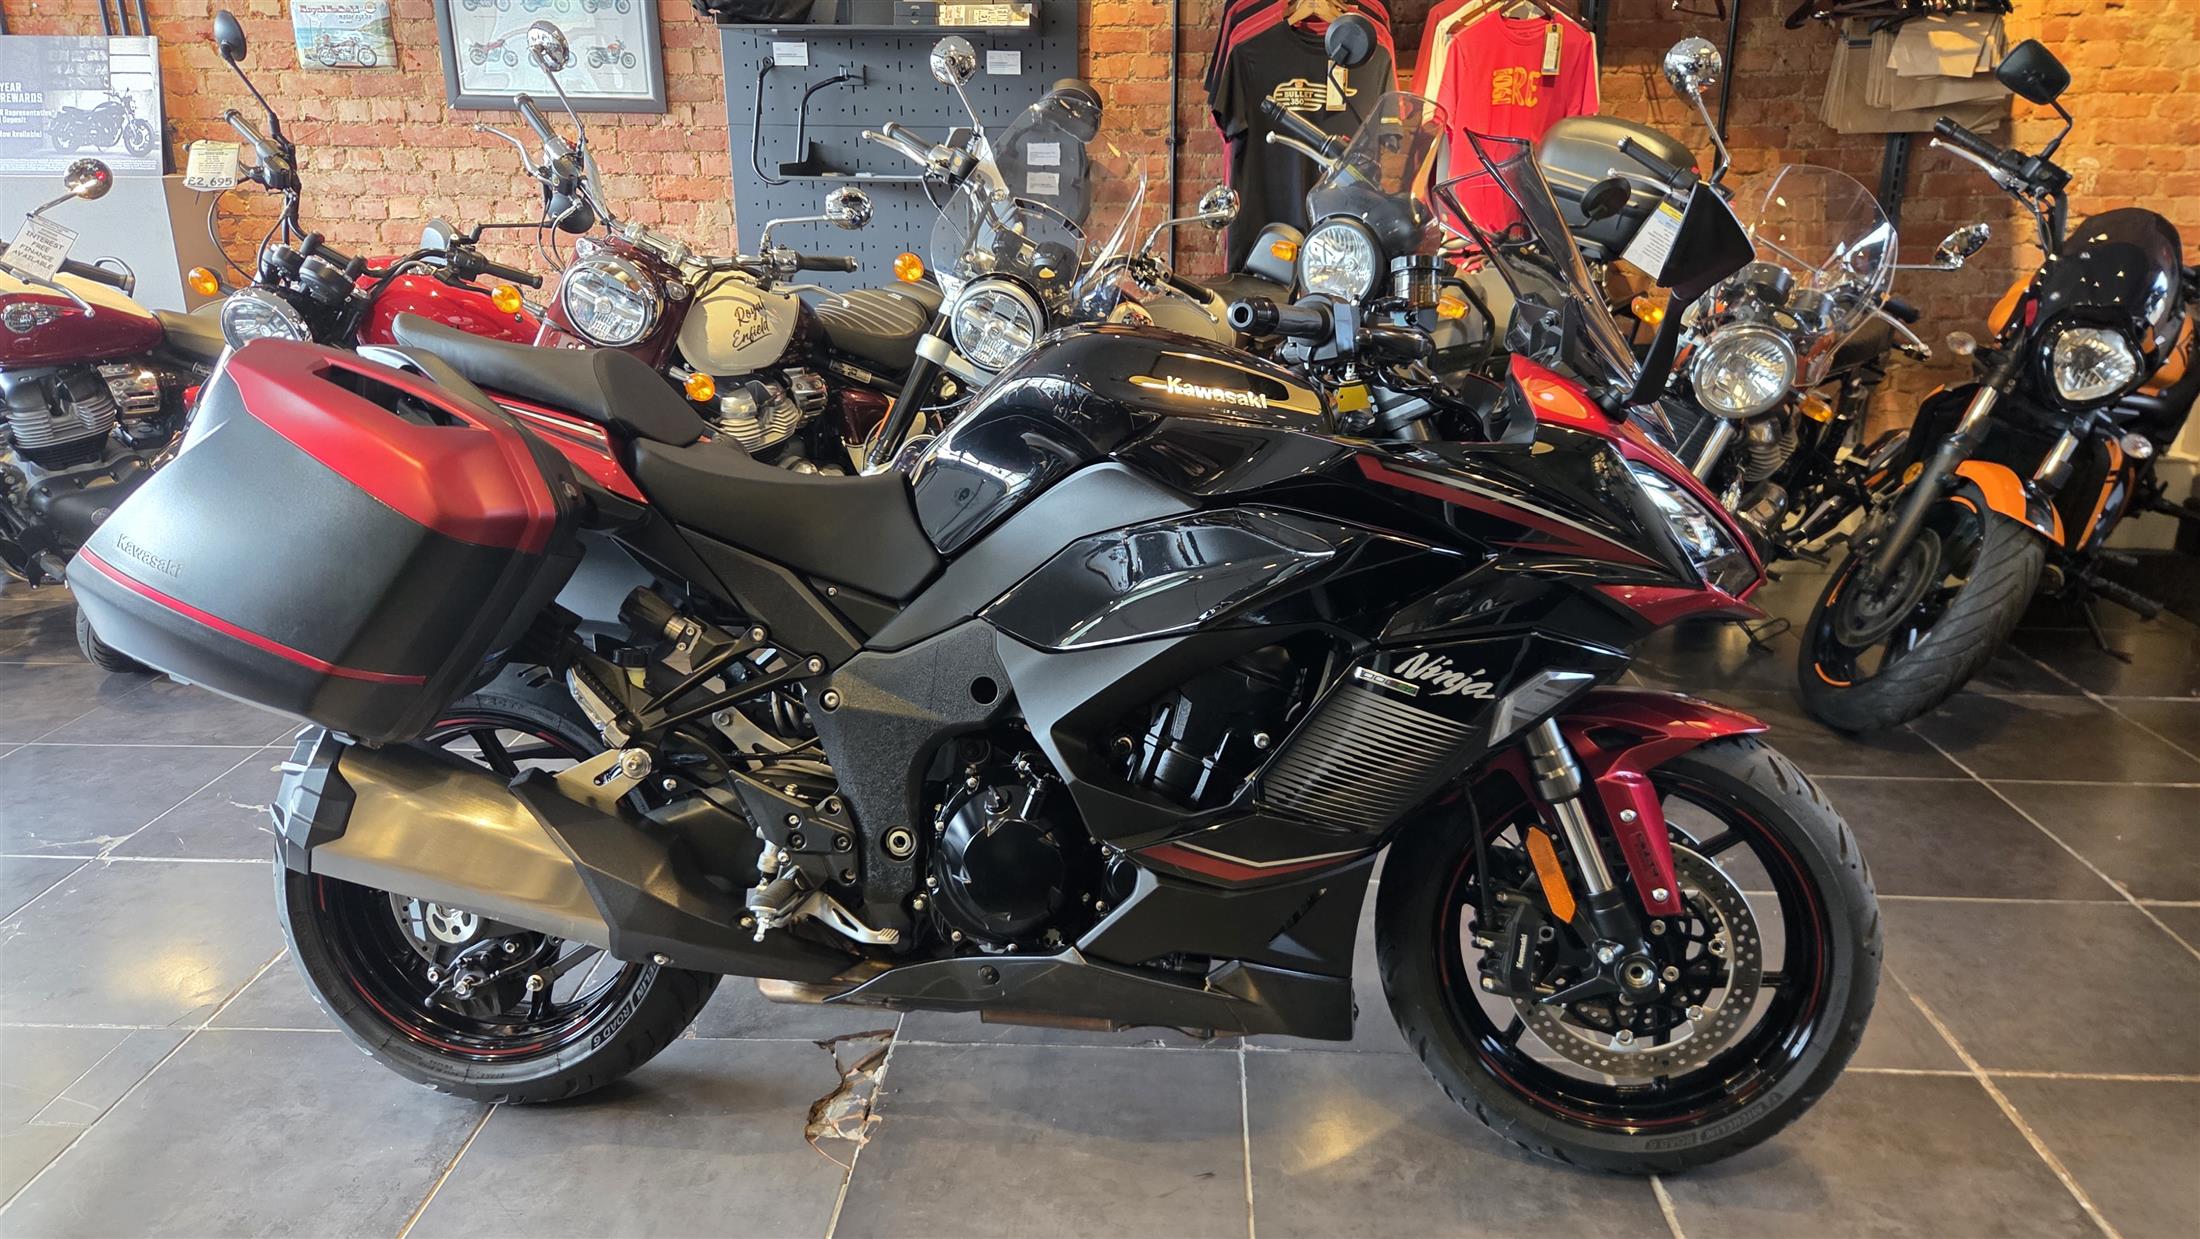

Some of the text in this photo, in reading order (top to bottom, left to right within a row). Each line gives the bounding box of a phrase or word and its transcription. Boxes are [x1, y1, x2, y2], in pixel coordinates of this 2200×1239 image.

[0, 82, 22, 92] YEAR
[0, 92, 43, 103] REWARDS
[1283, 91, 1314, 99] BULLET
[188, 176, 233, 188] £2,695
[26, 230, 64, 251] INTEREST
[31, 241, 51, 254] FREE
[12, 249, 54, 270] AVAILABLE
[20, 243, 55, 263] FINANCE
[734, 294, 767, 328] Royal
[732, 314, 770, 349] Enfield
[1166, 375, 1269, 409] Kawasaki
[117, 533, 183, 578] Kawasaki
[1394, 652, 1496, 699] Ninja
[602, 1006, 631, 1039] ROAD
